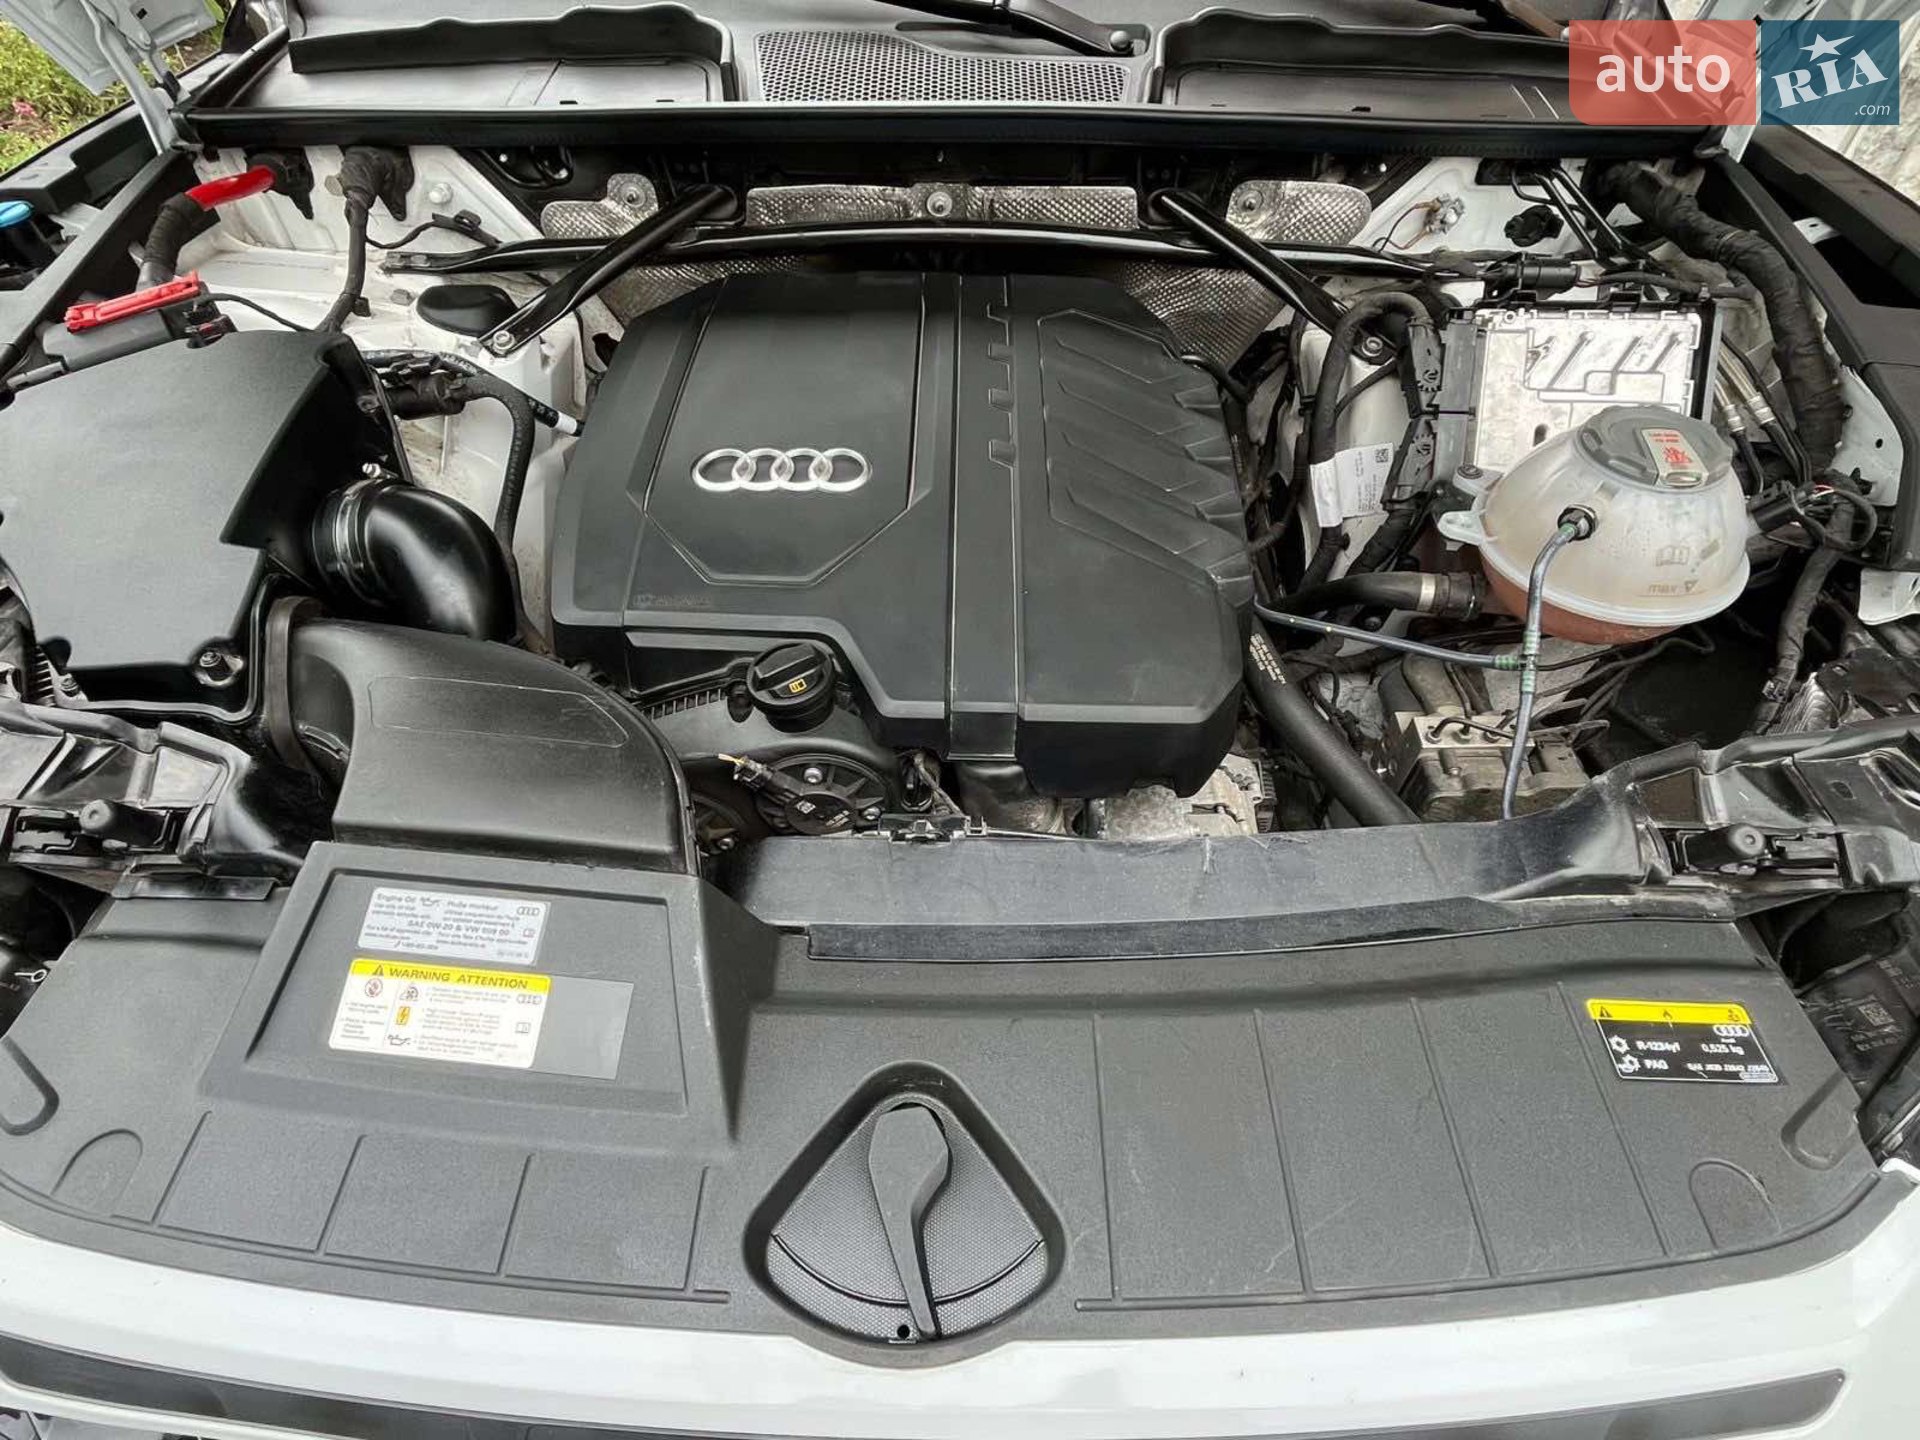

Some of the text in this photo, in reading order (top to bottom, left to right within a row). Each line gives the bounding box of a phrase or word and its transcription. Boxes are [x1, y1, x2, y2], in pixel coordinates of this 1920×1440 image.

[389, 967, 529, 989] WARNING ATTENTION
[1728, 1044, 1745, 1055] kg
